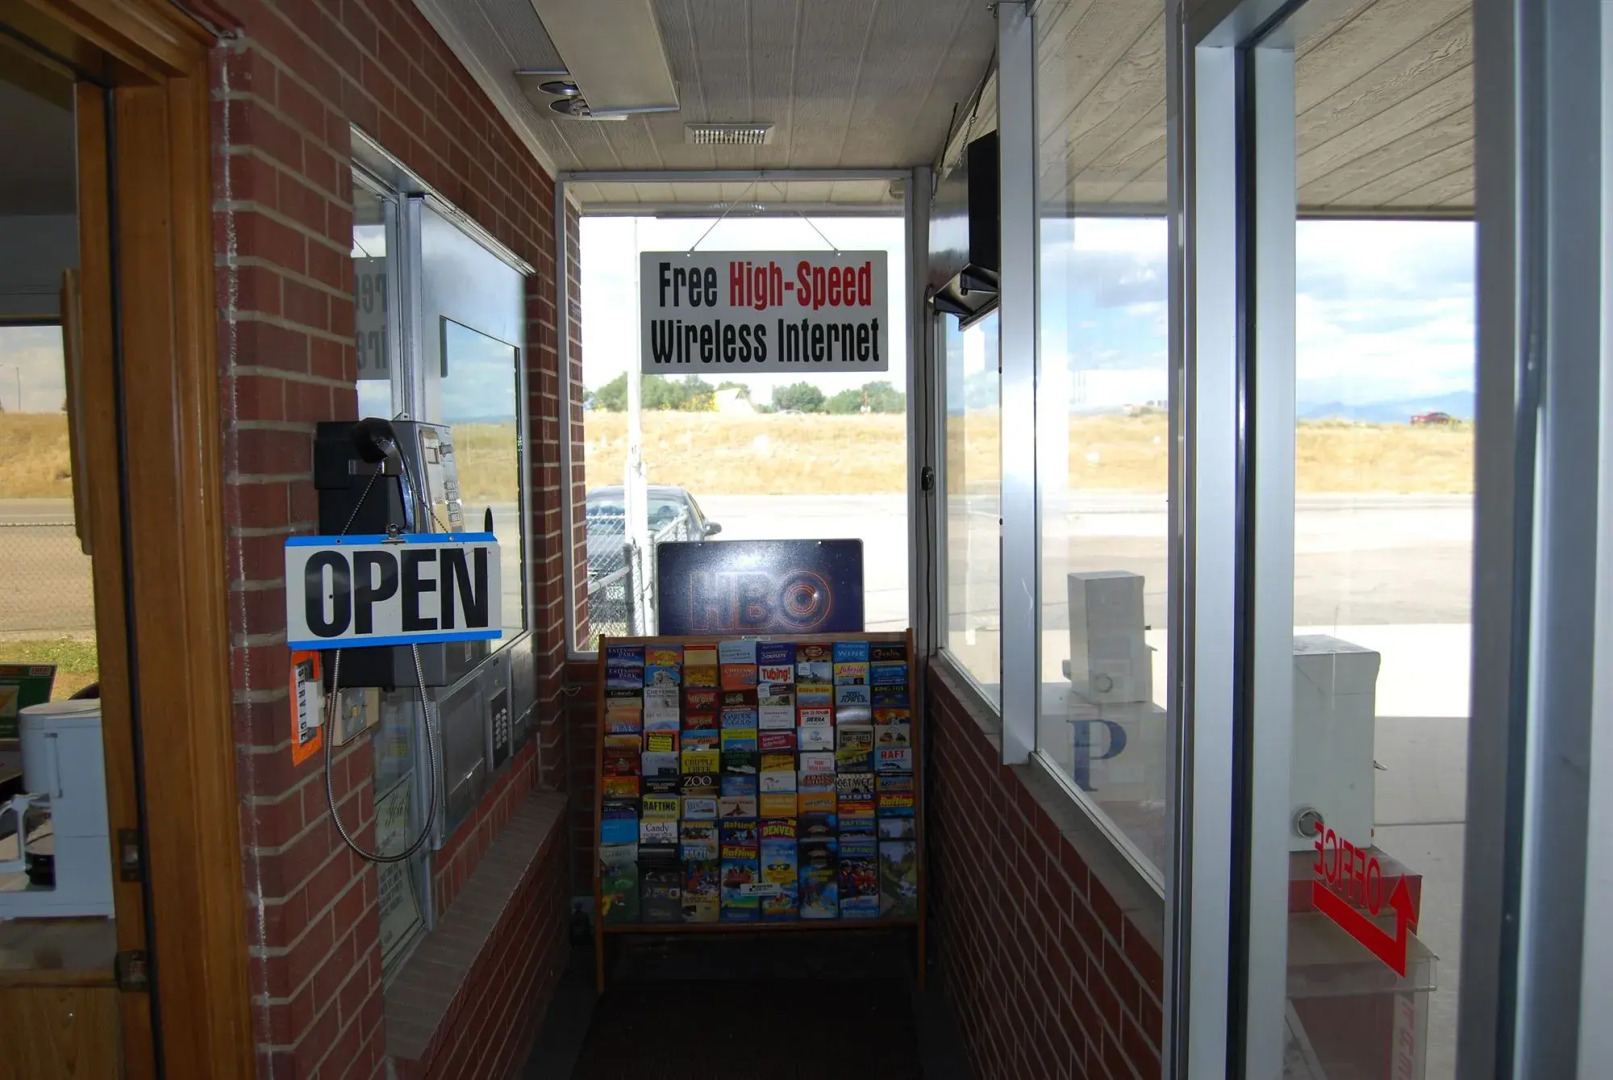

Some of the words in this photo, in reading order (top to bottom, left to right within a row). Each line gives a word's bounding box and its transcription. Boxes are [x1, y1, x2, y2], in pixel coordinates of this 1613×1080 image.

[659, 262, 718, 308] Free
[729, 261, 872, 311] High-Speed
[651, 319, 767, 364] Wireless
[777, 317, 880, 362] Internet
[304, 547, 489, 638] OPEN
[691, 571, 831, 630] HBO
[762, 667, 791, 681] Tubing!
[297, 667, 308, 740] SERVICE
[881, 750, 905, 760] RAFT
[684, 775, 713, 787] ZOO
[643, 801, 676, 811] RAFTING
[645, 823, 669, 833] Candy
[762, 825, 796, 838] DENVER
